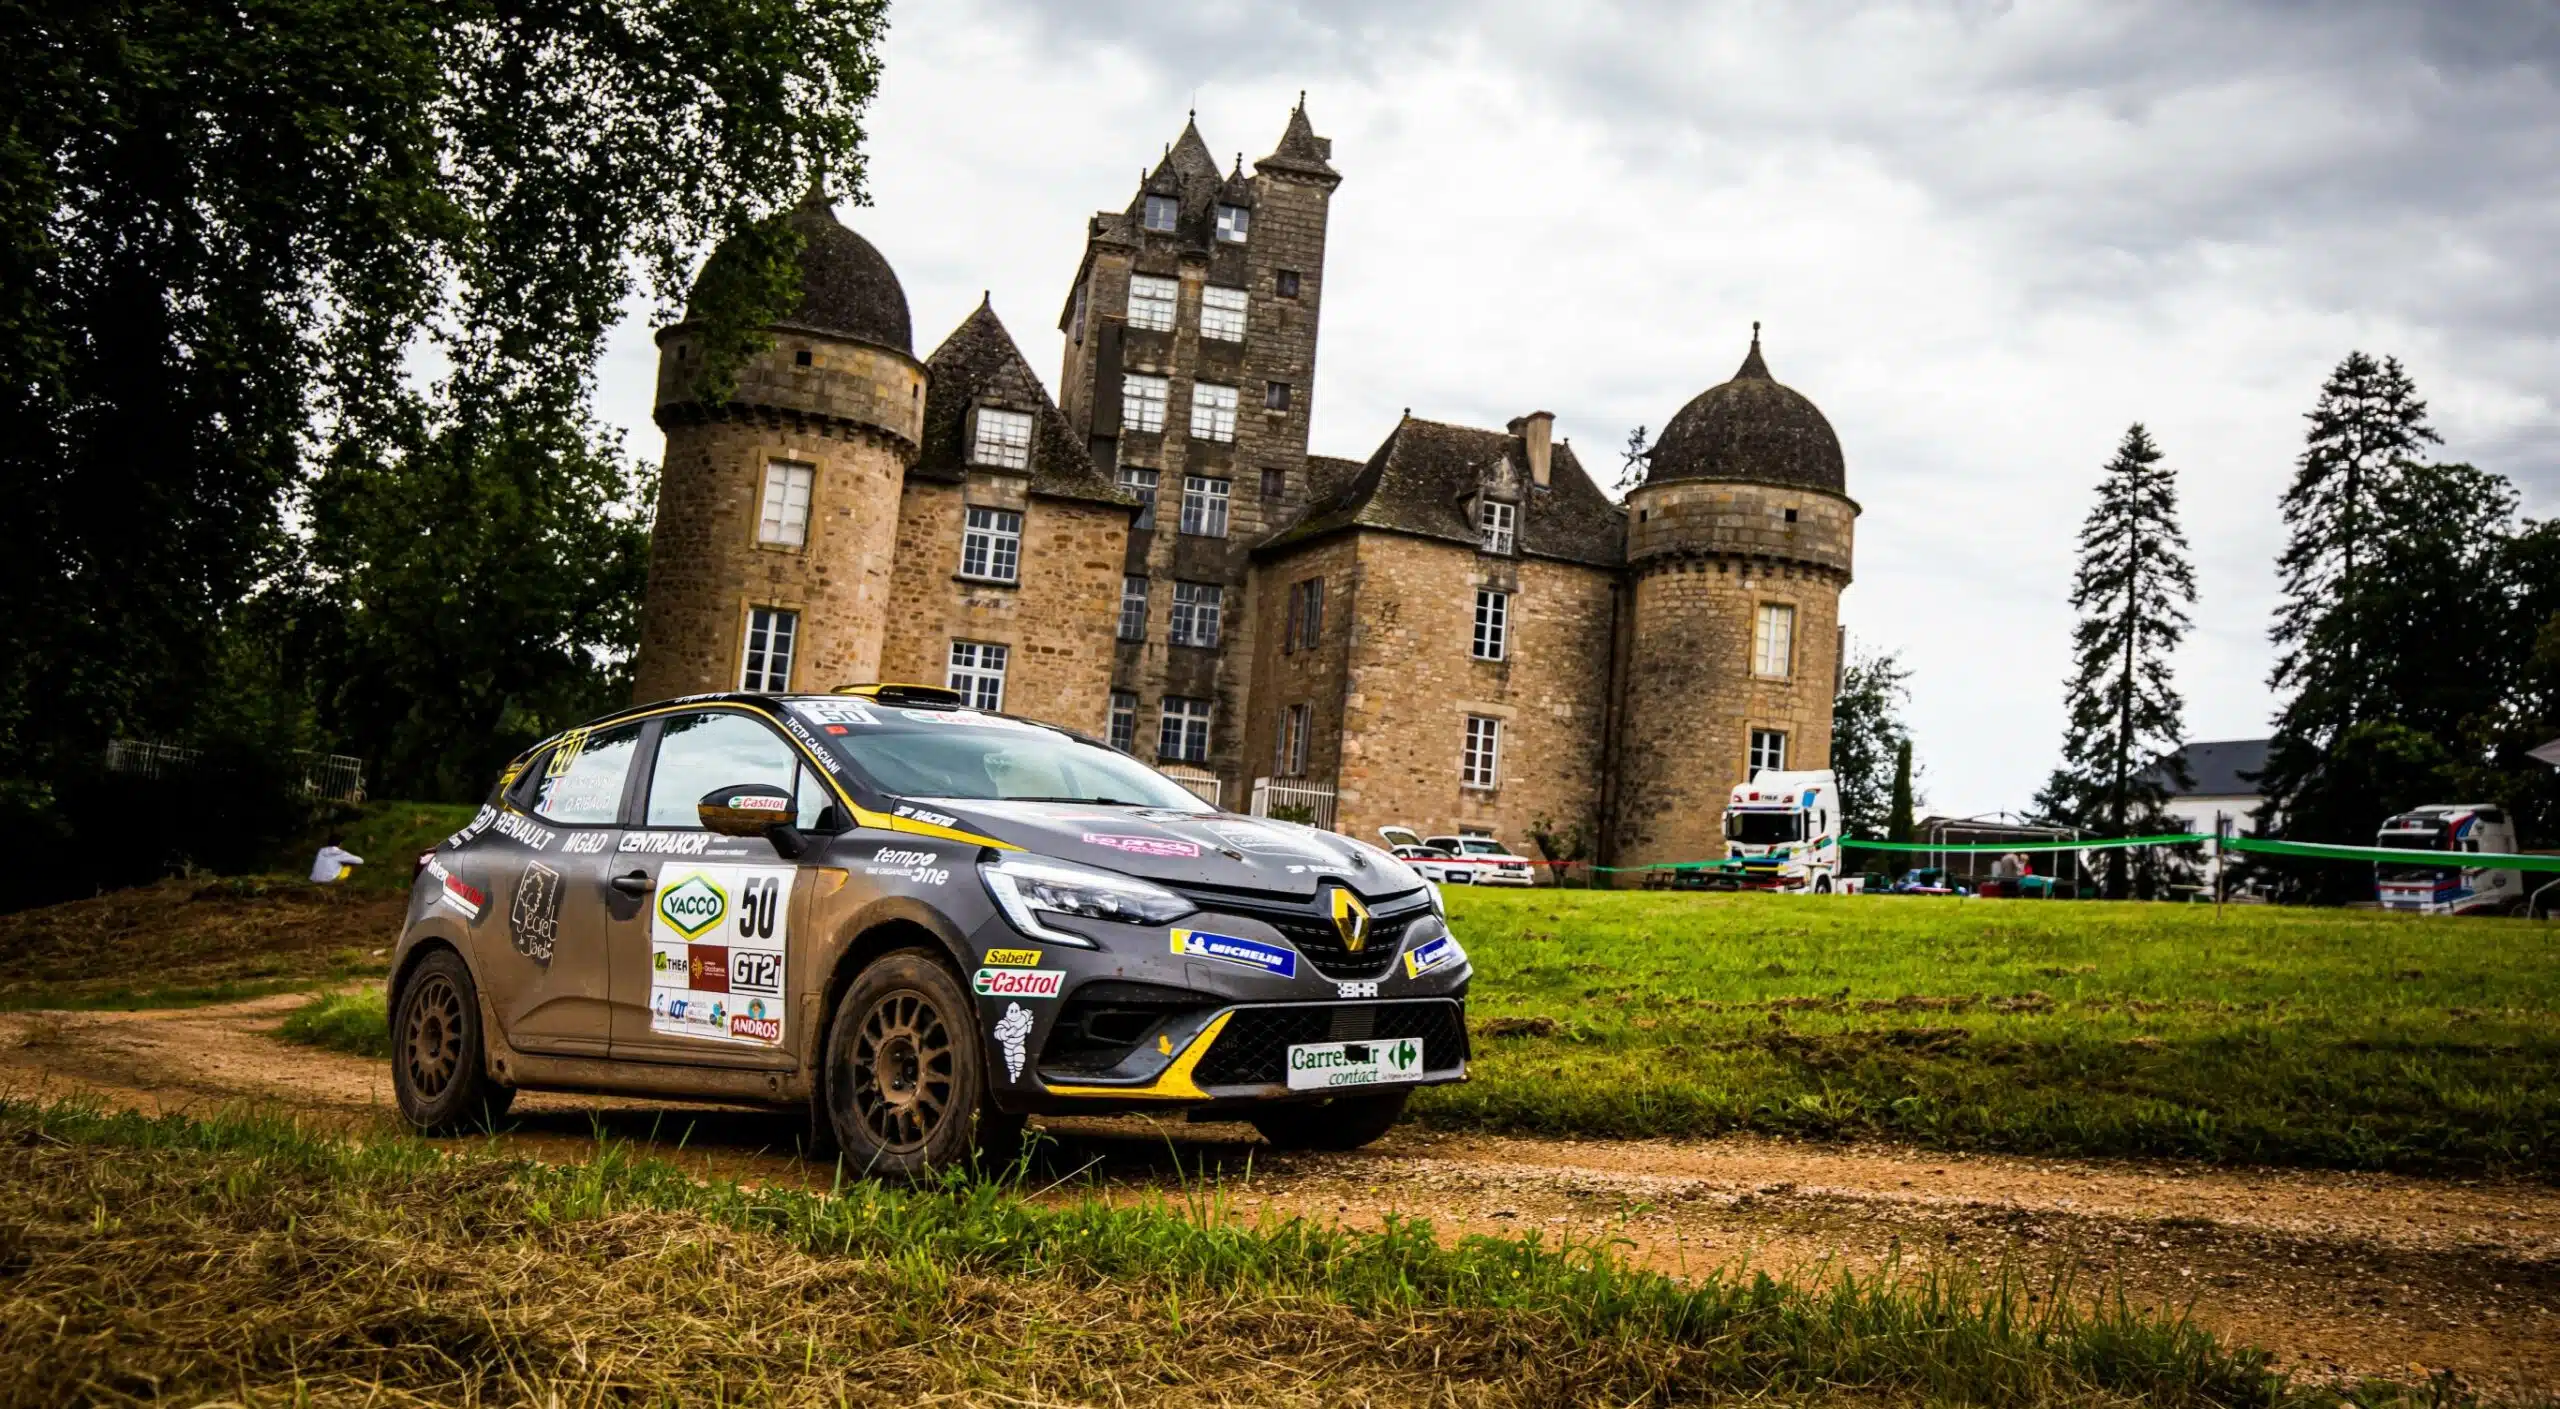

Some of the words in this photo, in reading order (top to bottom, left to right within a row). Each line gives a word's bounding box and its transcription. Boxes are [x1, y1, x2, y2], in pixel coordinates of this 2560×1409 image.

[818, 711, 866, 723] 50
[785, 717, 810, 740] TFCTP
[805, 737, 841, 774] CASCIANI
[742, 797, 785, 809] Castrol
[493, 811, 556, 851] RENAULT
[562, 832, 609, 853] MG&D
[618, 833, 710, 855] CENTRAKOR
[873, 846, 937, 868] tempo
[669, 895, 718, 916] YACCO
[739, 876, 780, 939] 50
[989, 950, 1036, 965] Sabelt
[1209, 942, 1284, 966] MICHELIN
[733, 952, 782, 988] GT2i
[992, 971, 1060, 994] Castrol
[670, 1000, 688, 1018] LOT
[733, 1018, 778, 1039] ANDROS
[1328, 1067, 1379, 1085] contact
